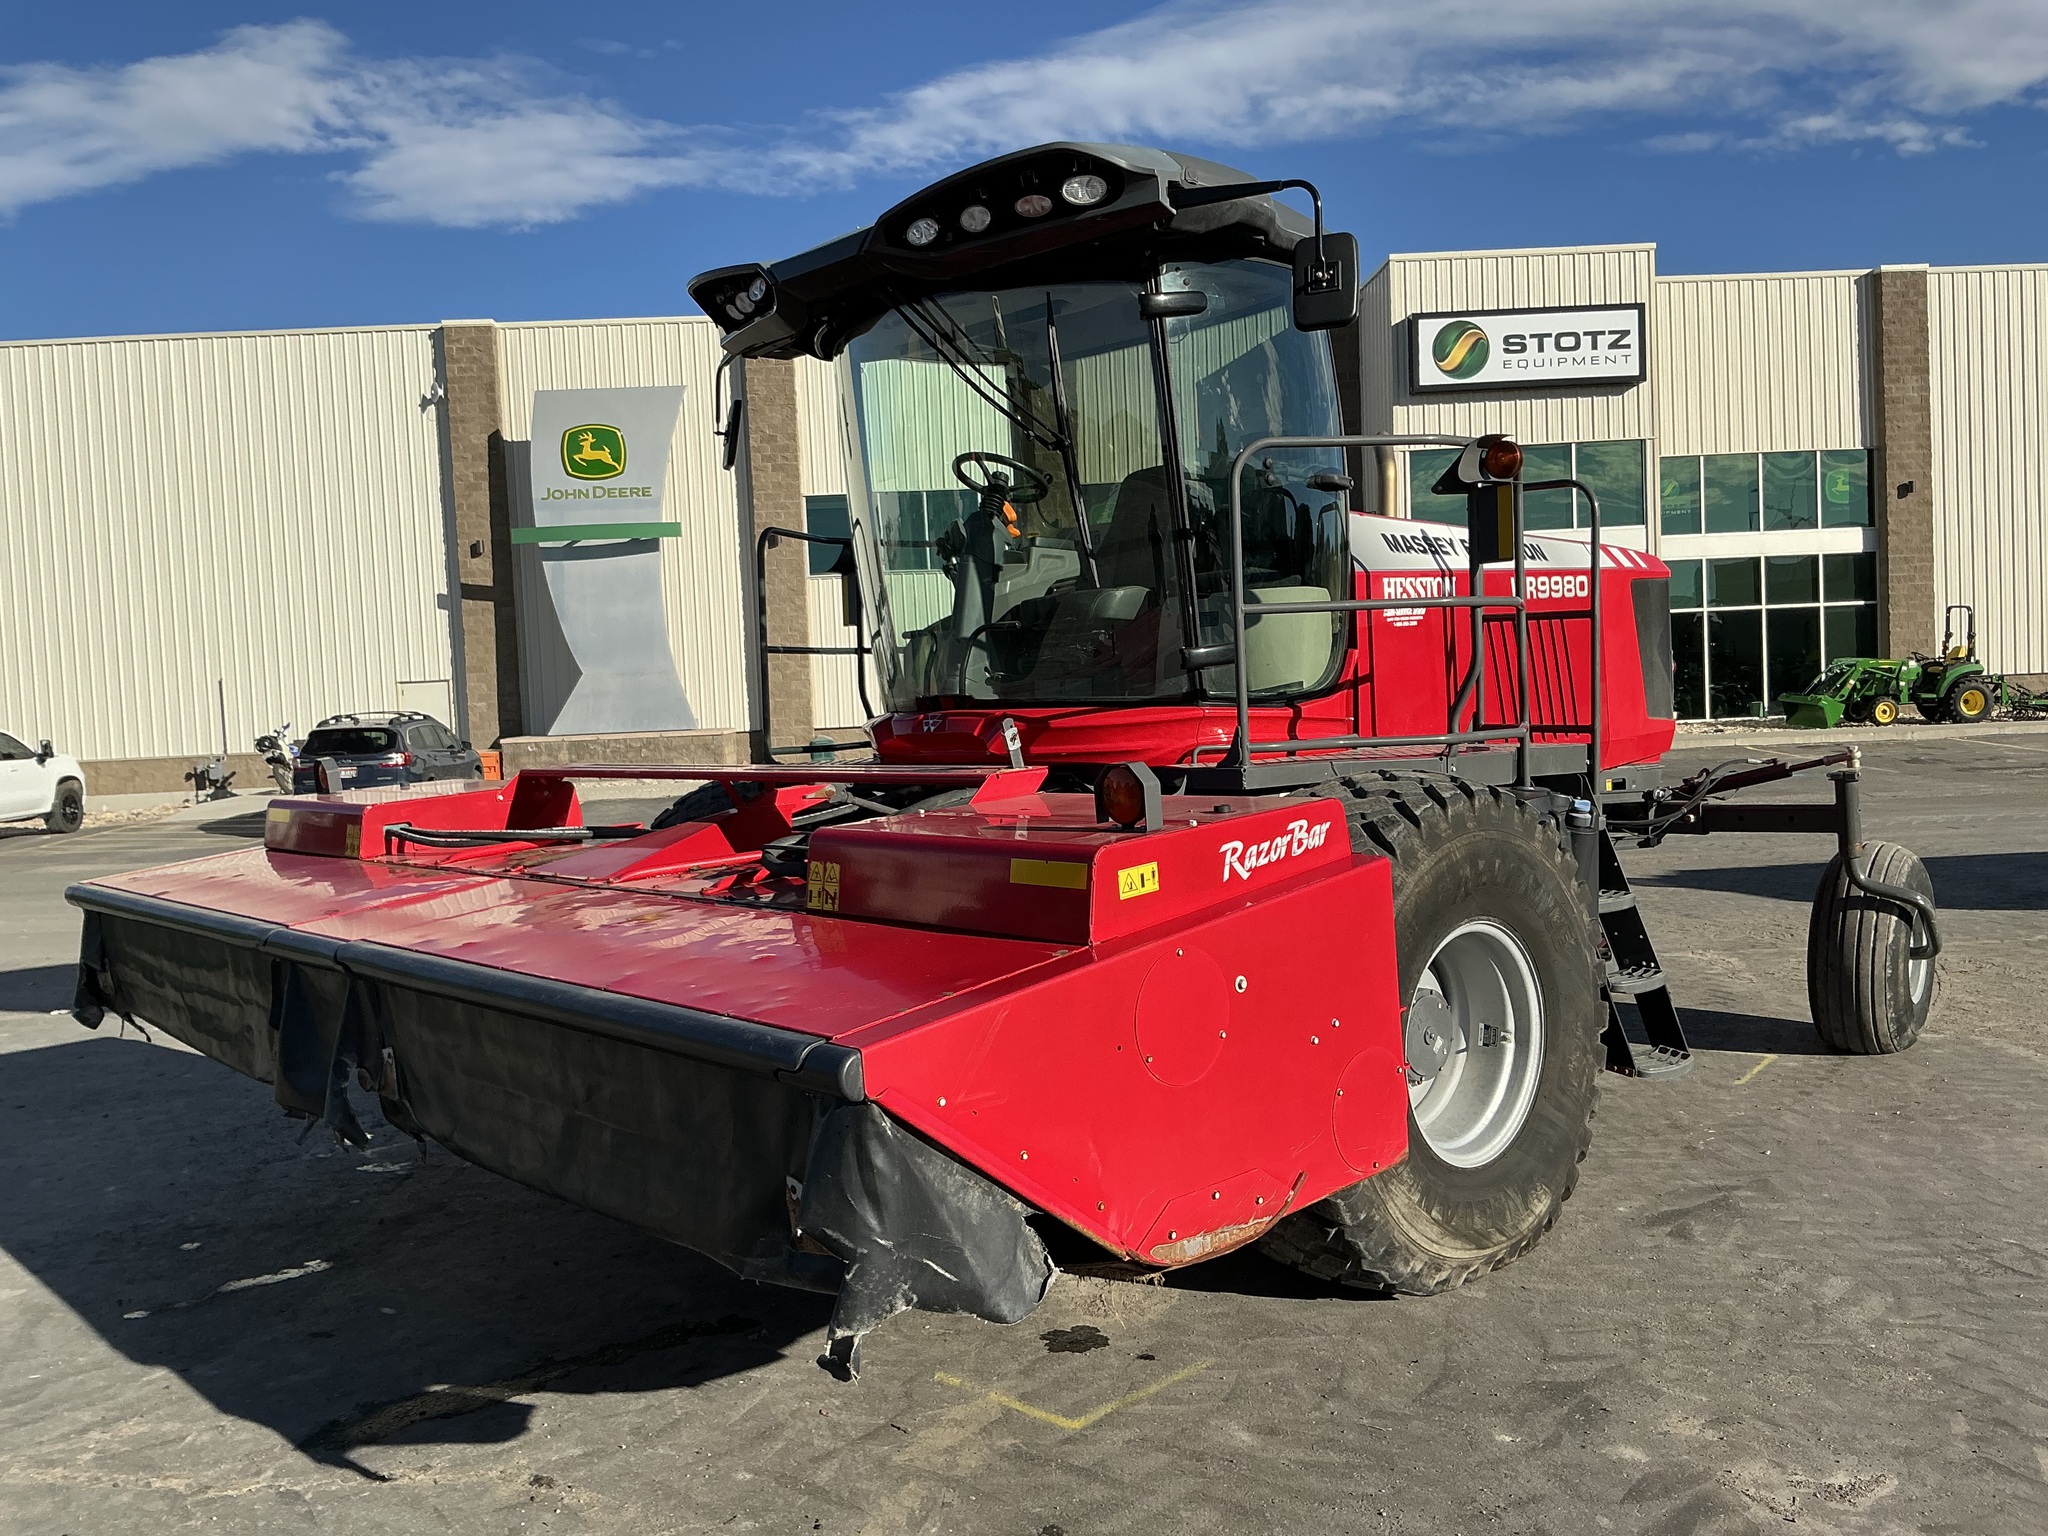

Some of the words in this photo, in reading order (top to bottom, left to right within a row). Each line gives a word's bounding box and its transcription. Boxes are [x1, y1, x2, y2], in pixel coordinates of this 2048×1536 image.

[1502, 329, 1632, 355] STOTZ
[1502, 354, 1632, 371] EQUIPMENT
[541, 487, 590, 501] JOHN
[592, 485, 653, 499] DEERE
[1380, 533, 1460, 556] MASSEY
[1382, 576, 1457, 600] HESSTON
[1219, 819, 1331, 882] RazorBar
